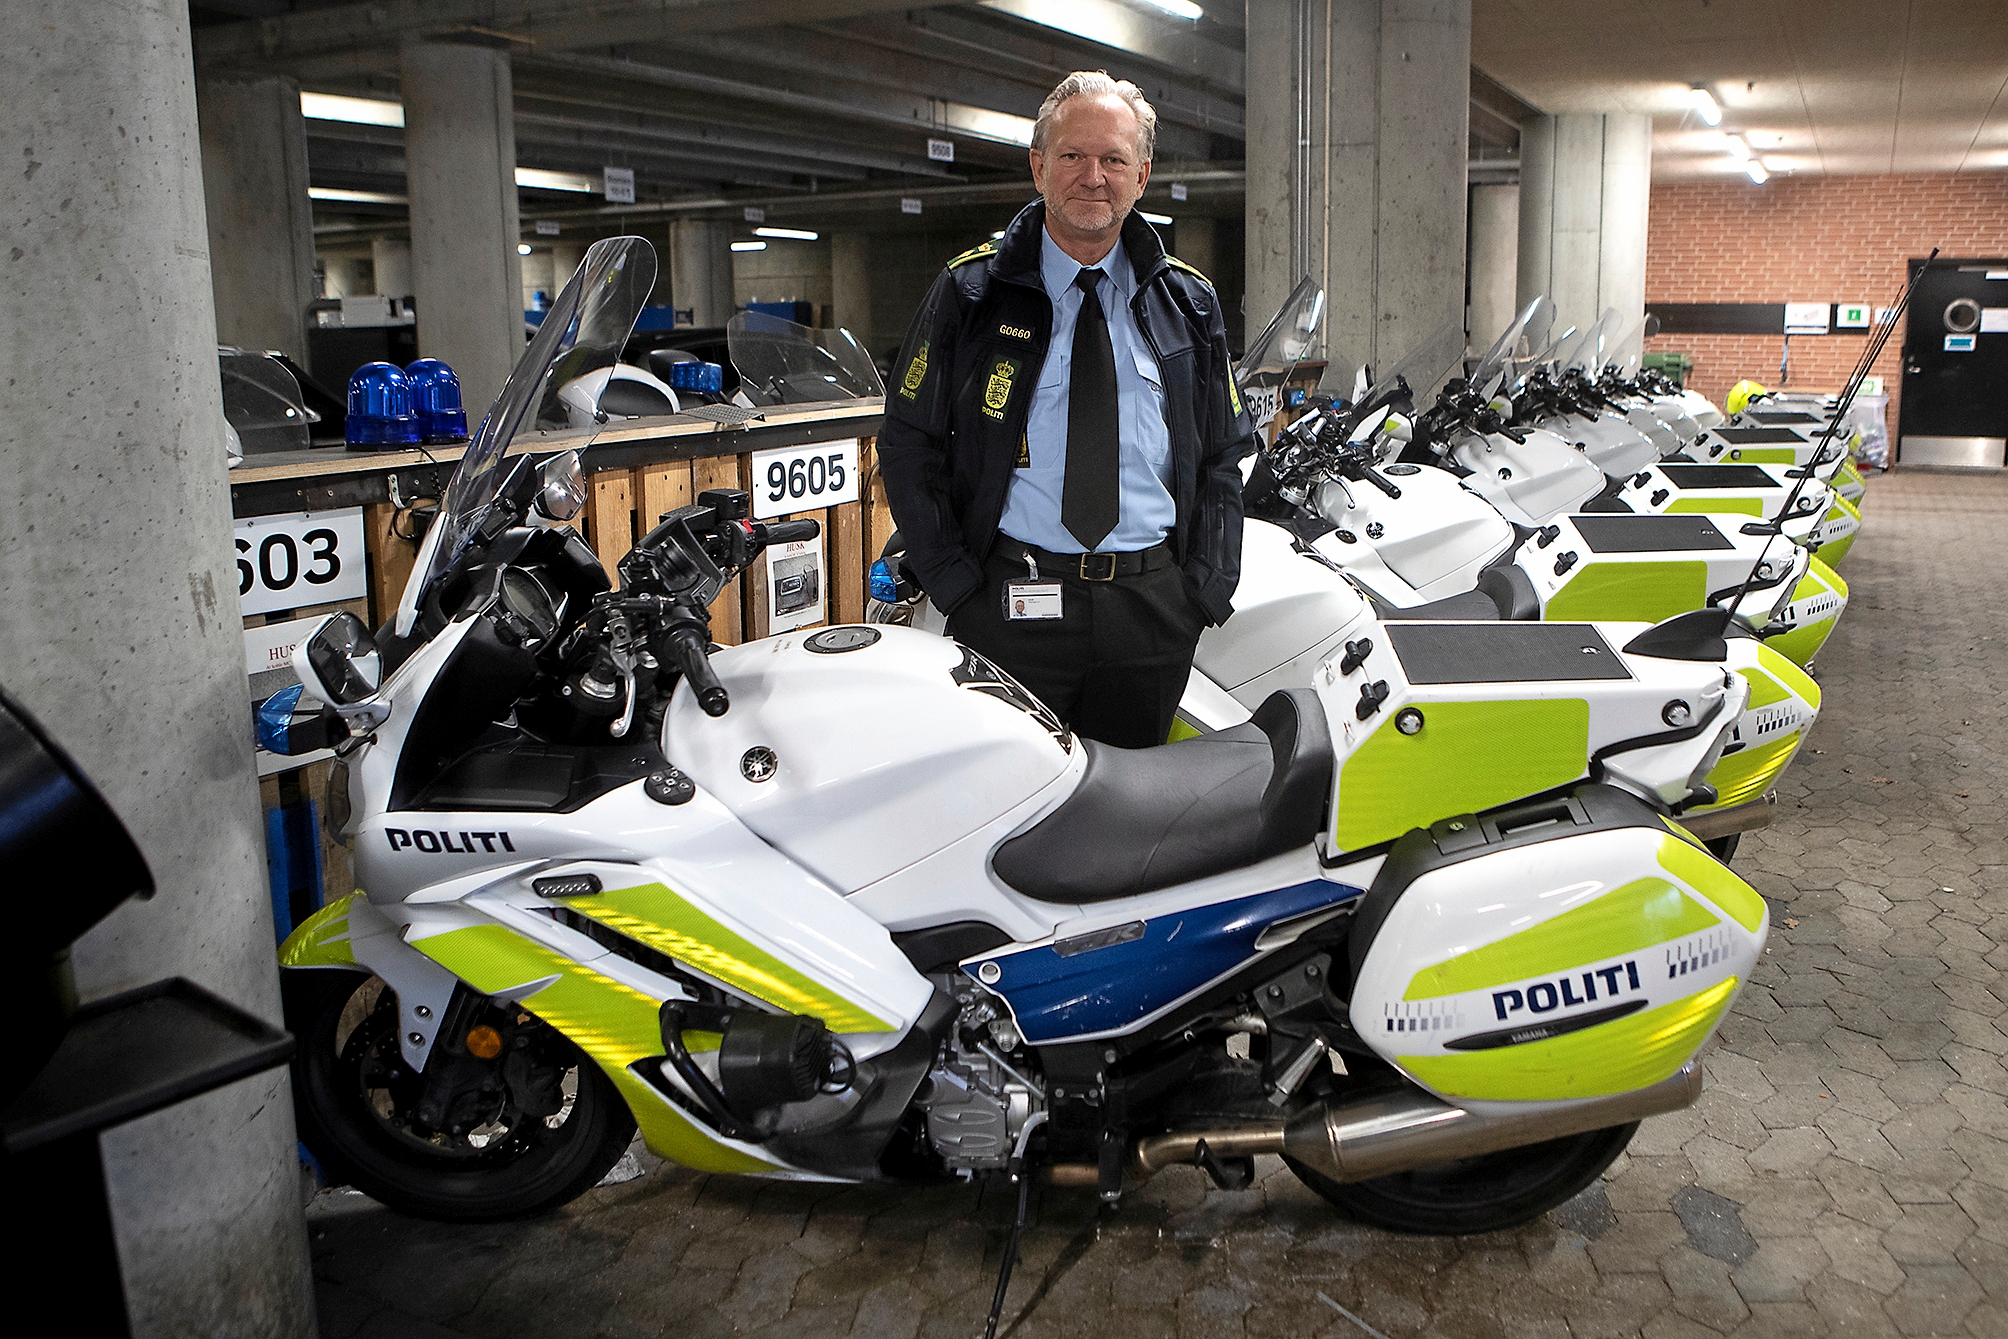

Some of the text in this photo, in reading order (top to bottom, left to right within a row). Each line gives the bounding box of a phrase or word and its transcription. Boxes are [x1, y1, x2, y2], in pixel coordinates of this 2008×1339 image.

[900, 386, 917, 400] POLITI
[982, 405, 1004, 420] POLITI
[767, 453, 846, 502] 9605
[384, 827, 516, 853] POLITI
[1492, 959, 1641, 1020] POLITI
